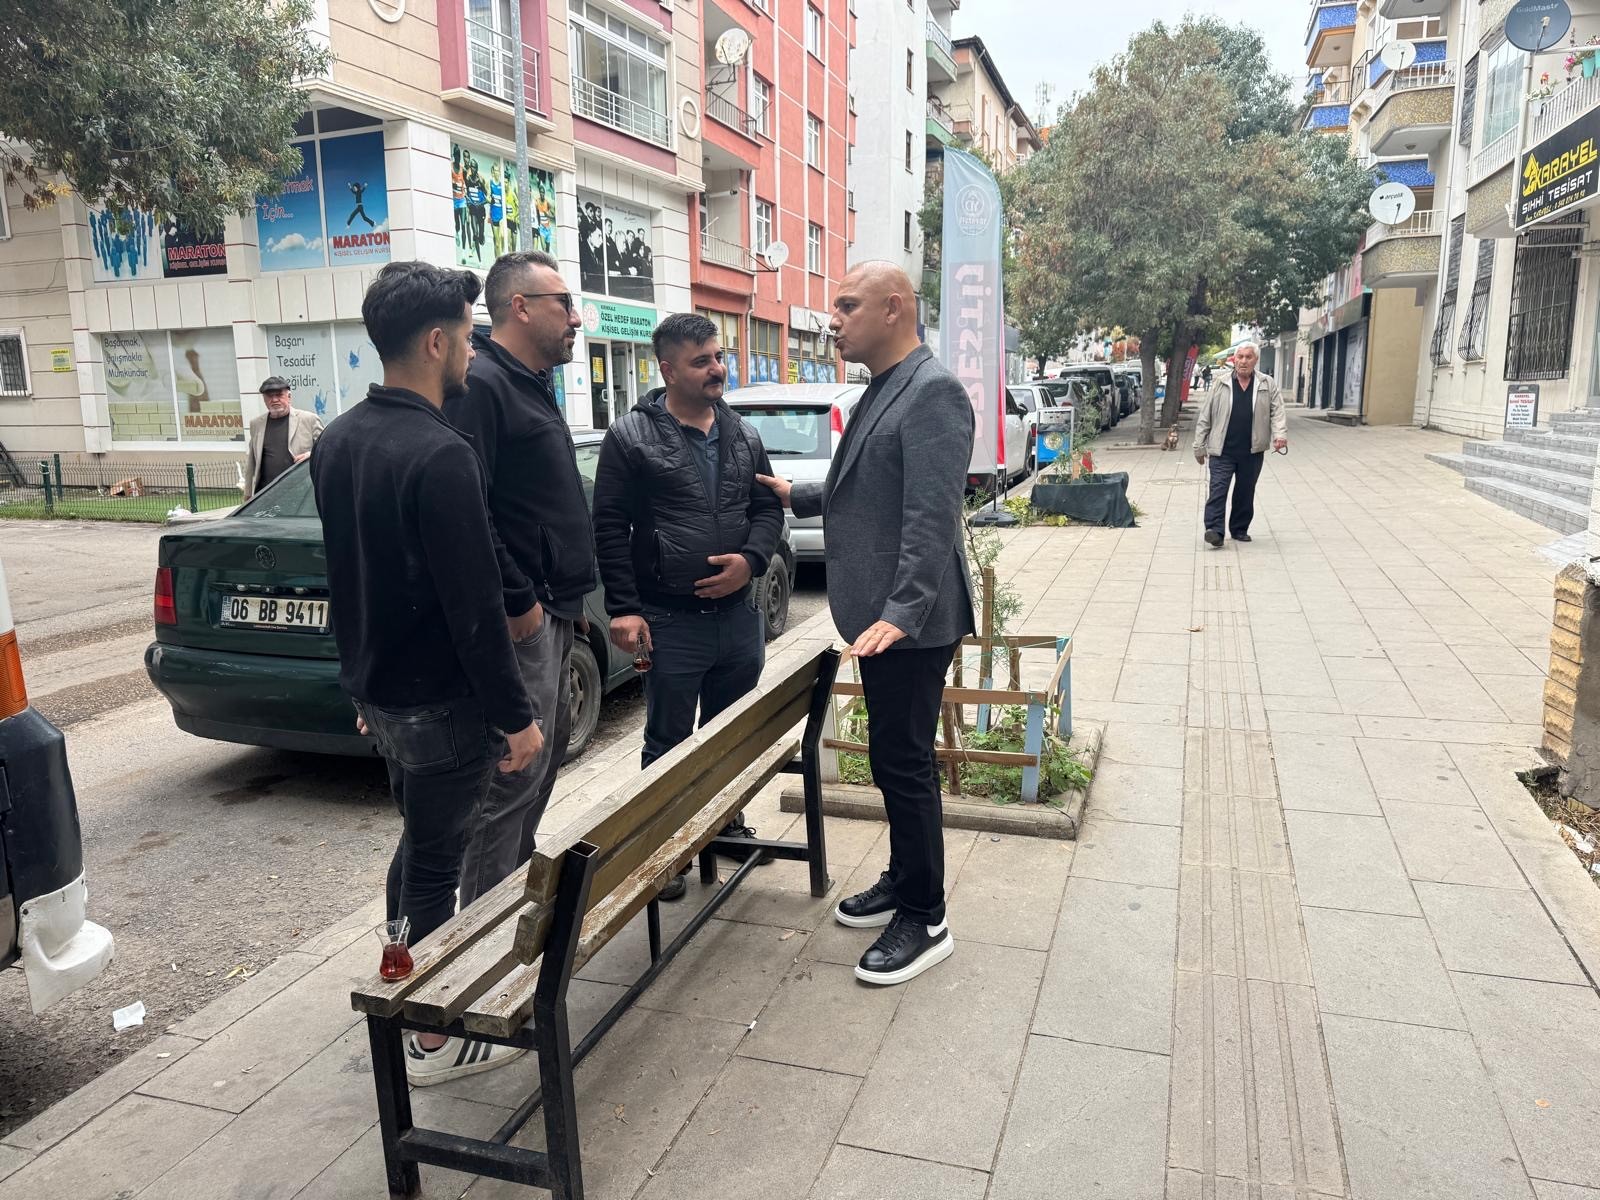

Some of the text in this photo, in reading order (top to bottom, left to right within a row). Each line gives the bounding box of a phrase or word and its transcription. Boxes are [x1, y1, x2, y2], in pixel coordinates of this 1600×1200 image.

[1548, 170, 1593, 201] TESİSAT
[333, 231, 390, 248] MARATON
[168, 244, 226, 260] MARATON
[601, 311, 651, 326] ÖZEL HEDEF MARATON
[602, 324, 620, 335] KİŞİSEL
[621, 327, 639, 338] GELİŞİM
[274, 335, 305, 349] Başarı
[276, 353, 316, 367] Tesadüf
[278, 374, 320, 390] eğildir.
[184, 415, 244, 428] MARATON
[231, 599, 324, 625] 06 BB 9411
